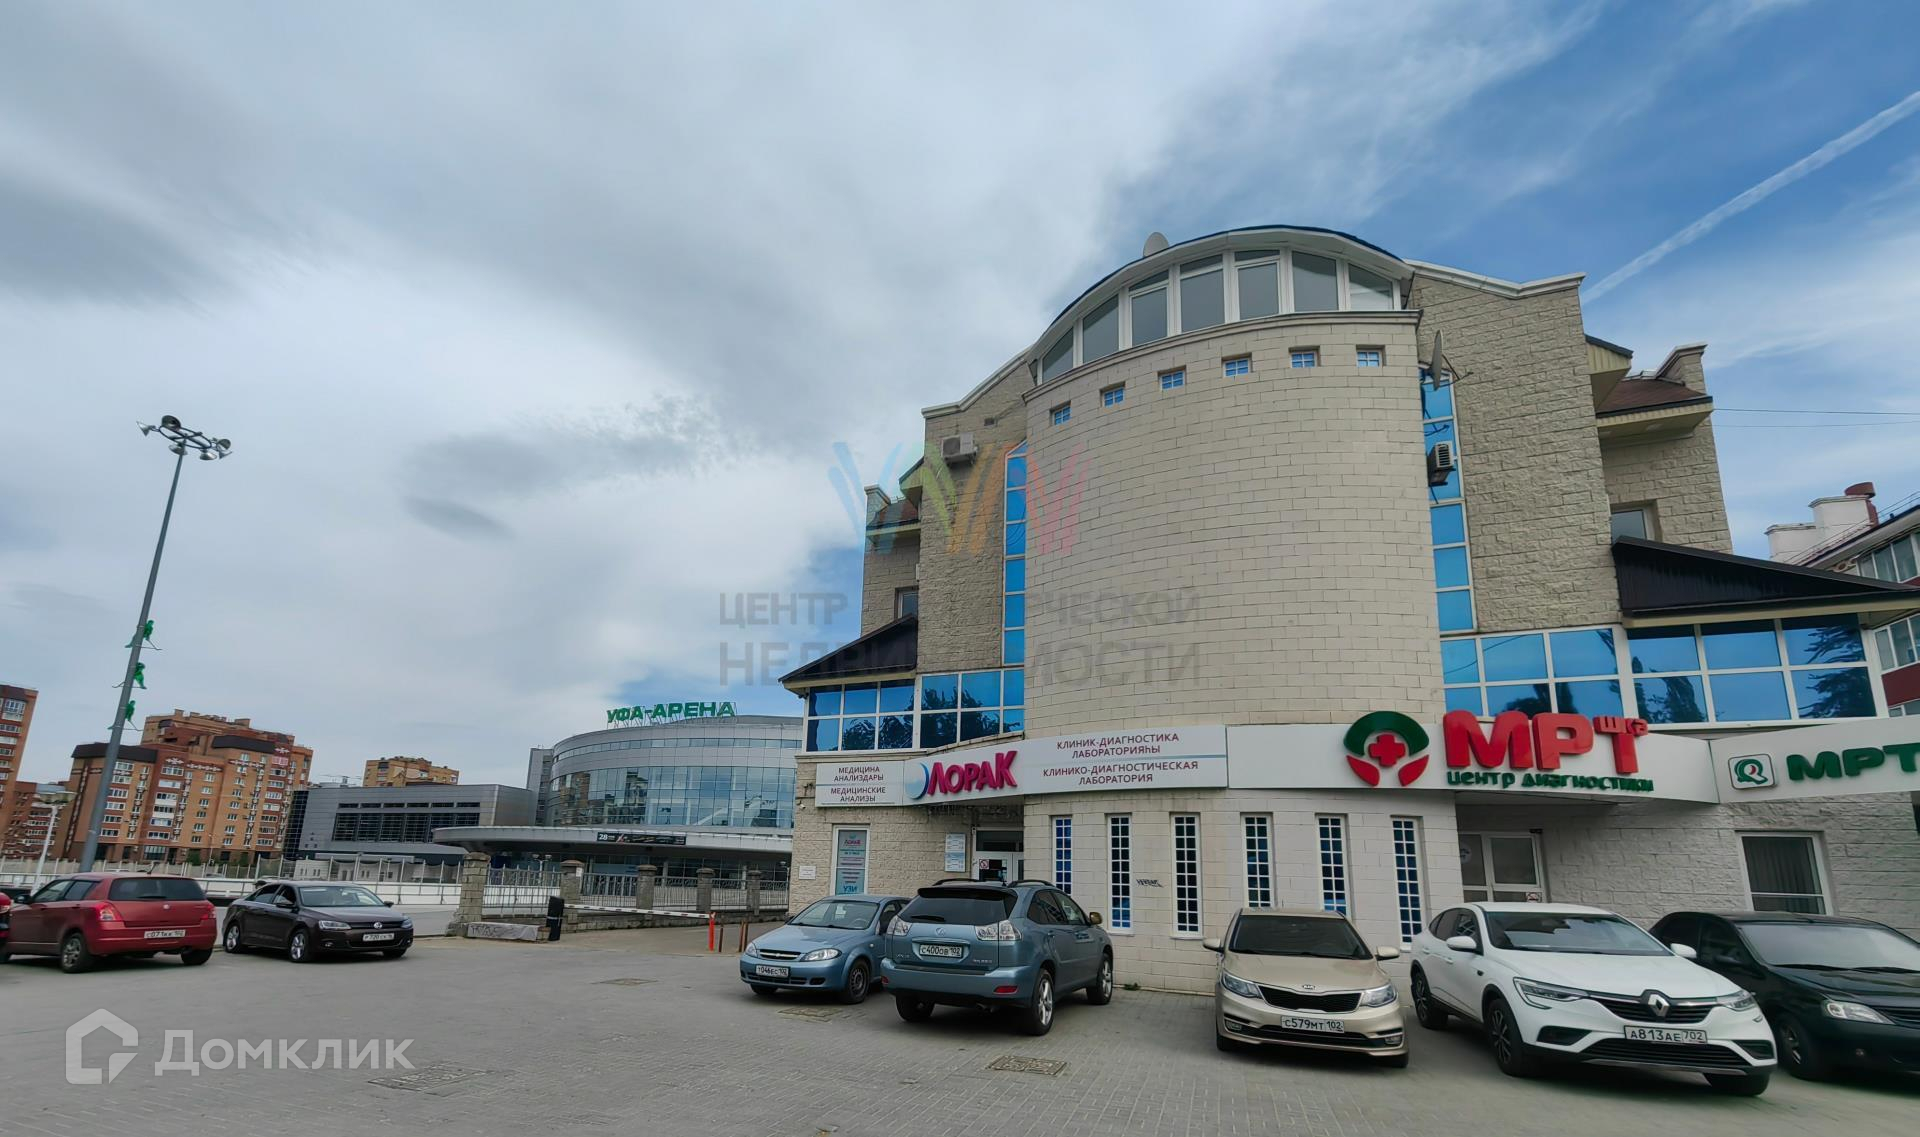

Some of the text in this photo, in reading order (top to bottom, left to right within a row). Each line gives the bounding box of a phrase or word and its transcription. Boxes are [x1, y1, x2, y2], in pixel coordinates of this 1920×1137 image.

[607, 701, 735, 723] УФА-АРЕНА
[1057, 733, 1179, 750] КЛИНИК-ДИАГНОСТИКА
[1043, 760, 1199, 777] КЛИНИКО-ДИАГНОСТИЧЕСКАЯ
[1786, 743, 1920, 781] МРТ
[834, 774, 884, 782] АНАЛИЗДАРЫ
[838, 766, 880, 775] МЕДИЦИНА
[927, 751, 1017, 796] ЛОРАК
[1078, 773, 1153, 786] ЛАБОРАТОРИЯ
[830, 786, 886, 795] МЕДИЦИНСКИЕ
[840, 795, 876, 803] АНАЛИЗЫ
